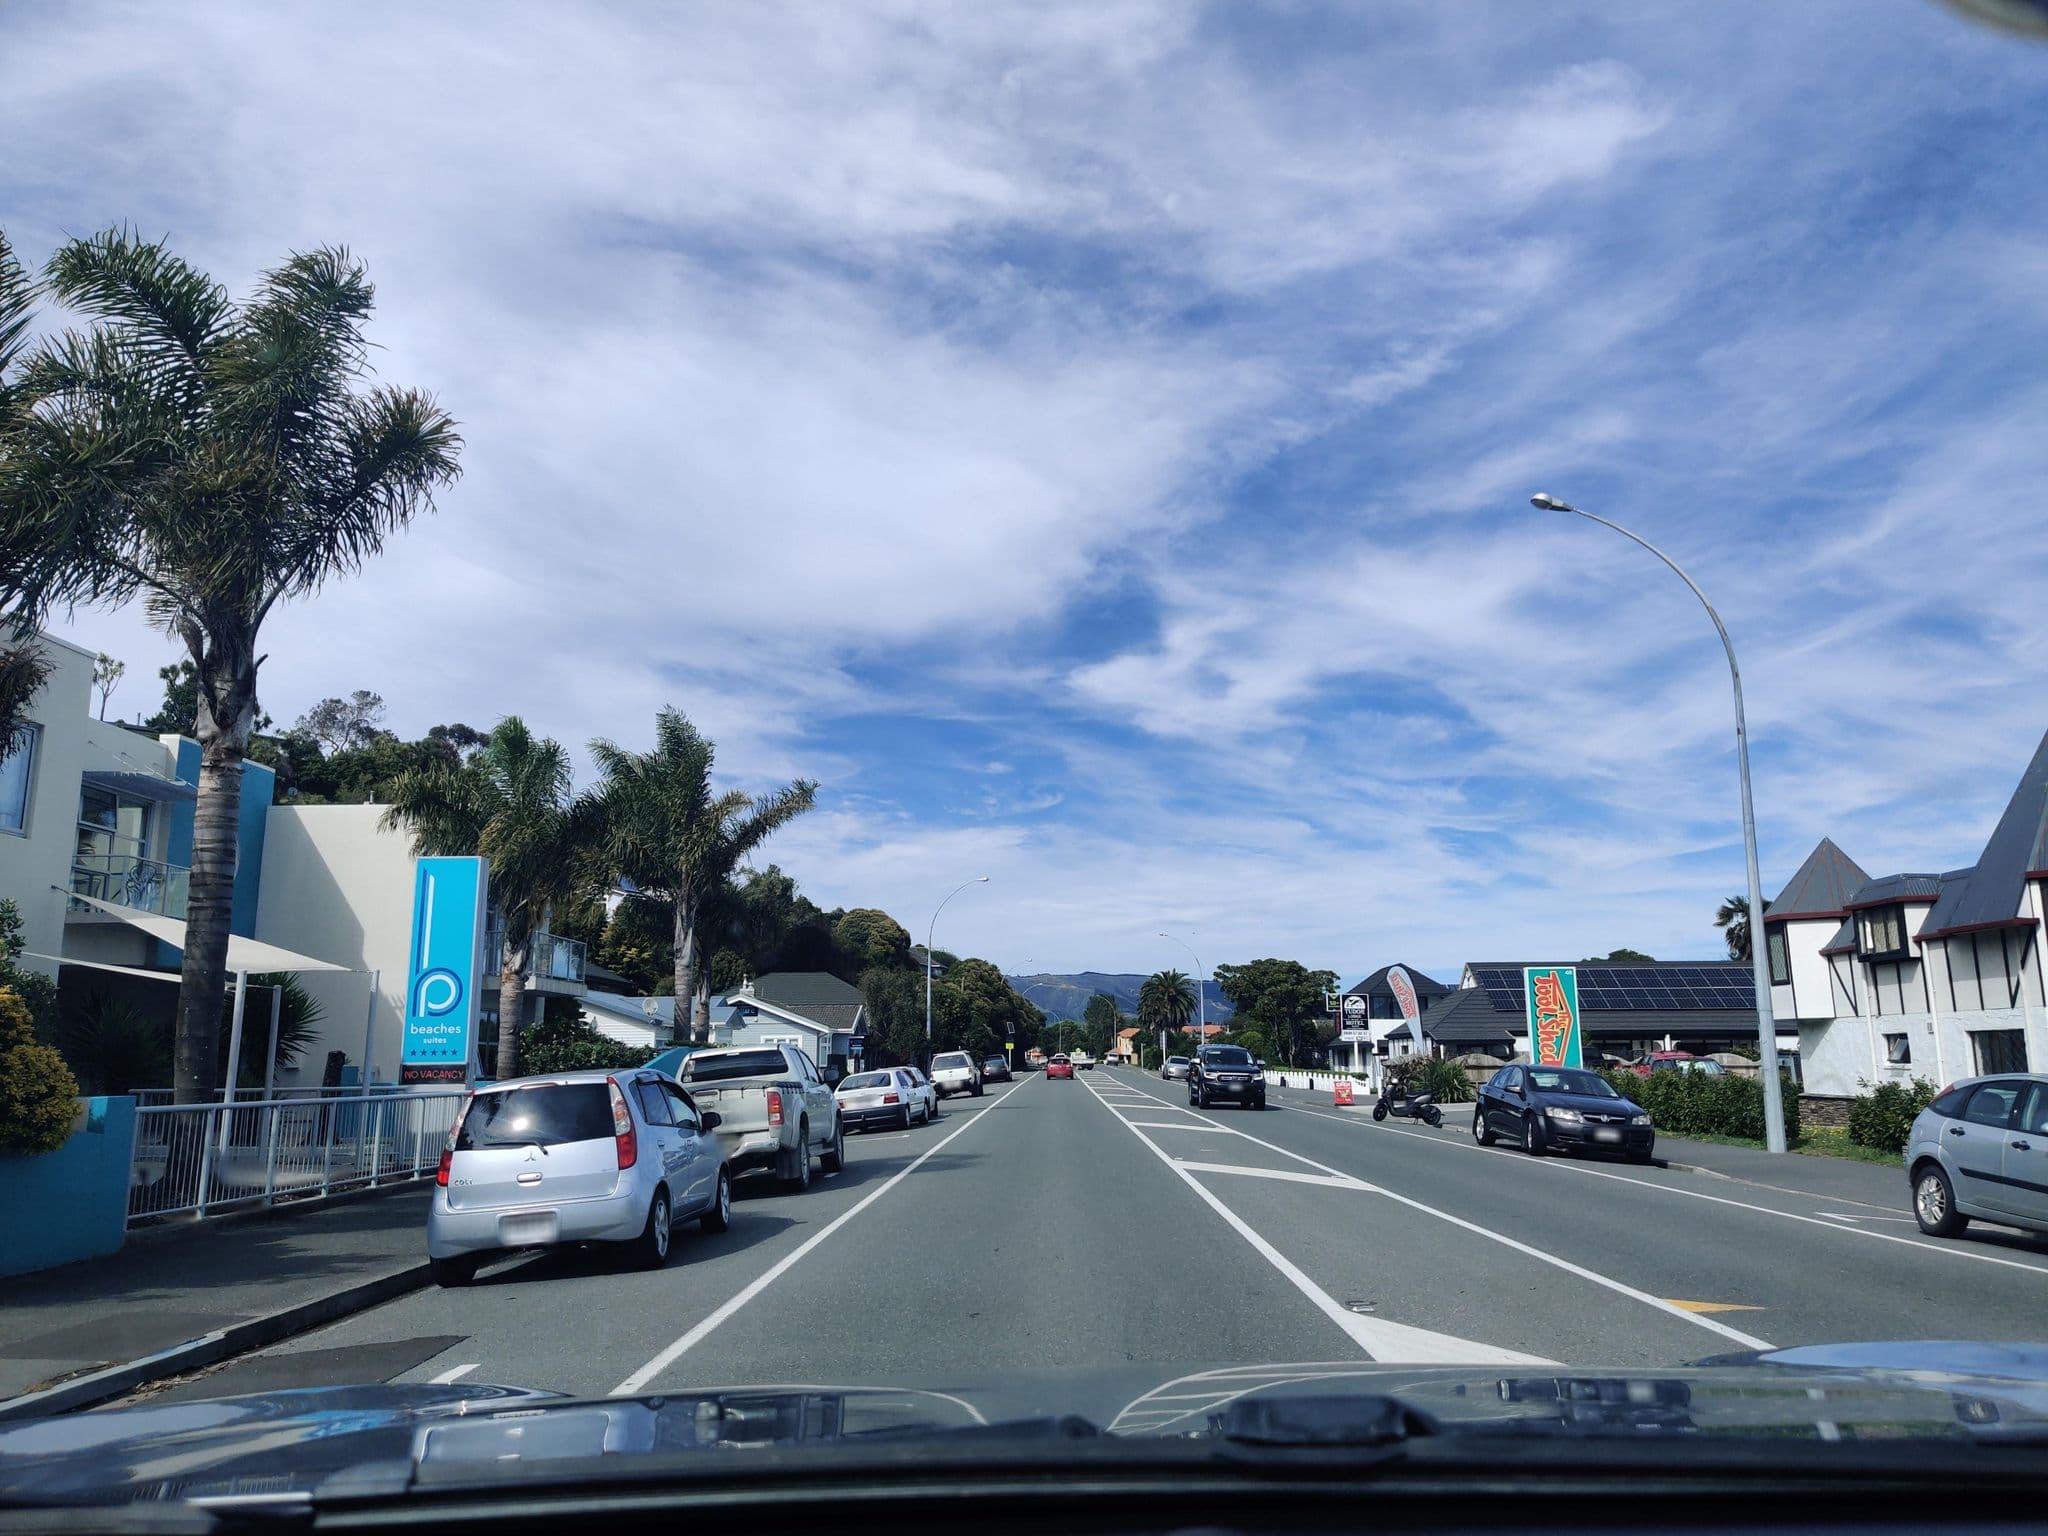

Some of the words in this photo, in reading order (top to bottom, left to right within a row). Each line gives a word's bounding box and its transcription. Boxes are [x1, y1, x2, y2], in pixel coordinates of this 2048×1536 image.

[1534, 971, 1558, 1017] Tool
[410, 1023, 462, 1034] beaches
[404, 1070, 419, 1079] NO
[420, 1070, 464, 1079] VACANCY
